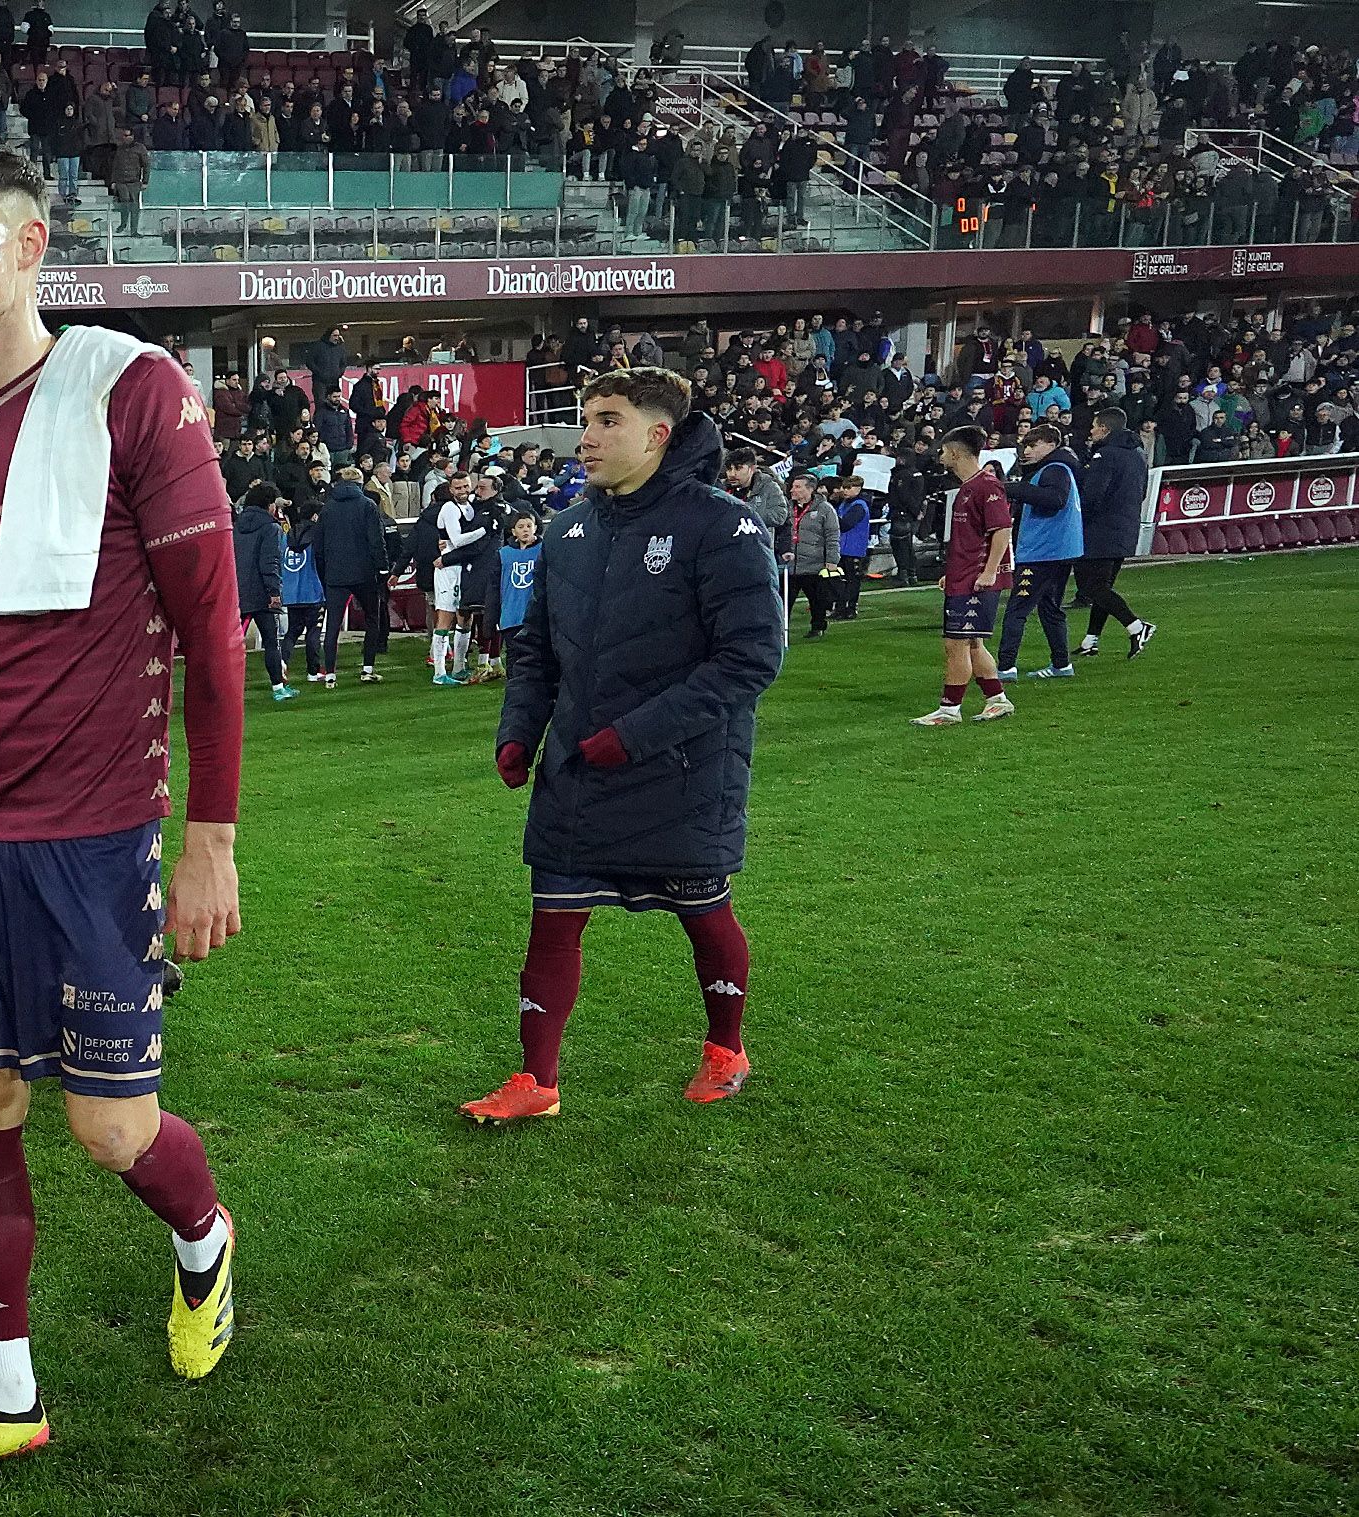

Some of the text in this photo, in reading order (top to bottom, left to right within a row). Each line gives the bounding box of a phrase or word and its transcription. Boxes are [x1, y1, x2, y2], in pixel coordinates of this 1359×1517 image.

[1149, 254, 1175, 264] XUNTA
[1247, 251, 1271, 261] XUNTA
[38, 271, 78, 282] SERVAS
[122, 283, 169, 294] PESCAMAR
[180, 520, 216, 537] VOLTAR
[77, 990, 116, 1001] XUNTA
[77, 1000, 136, 1013] DE GALICIA
[84, 1037, 134, 1049] DEPORTE
[83, 1050, 130, 1063] GALEGO
